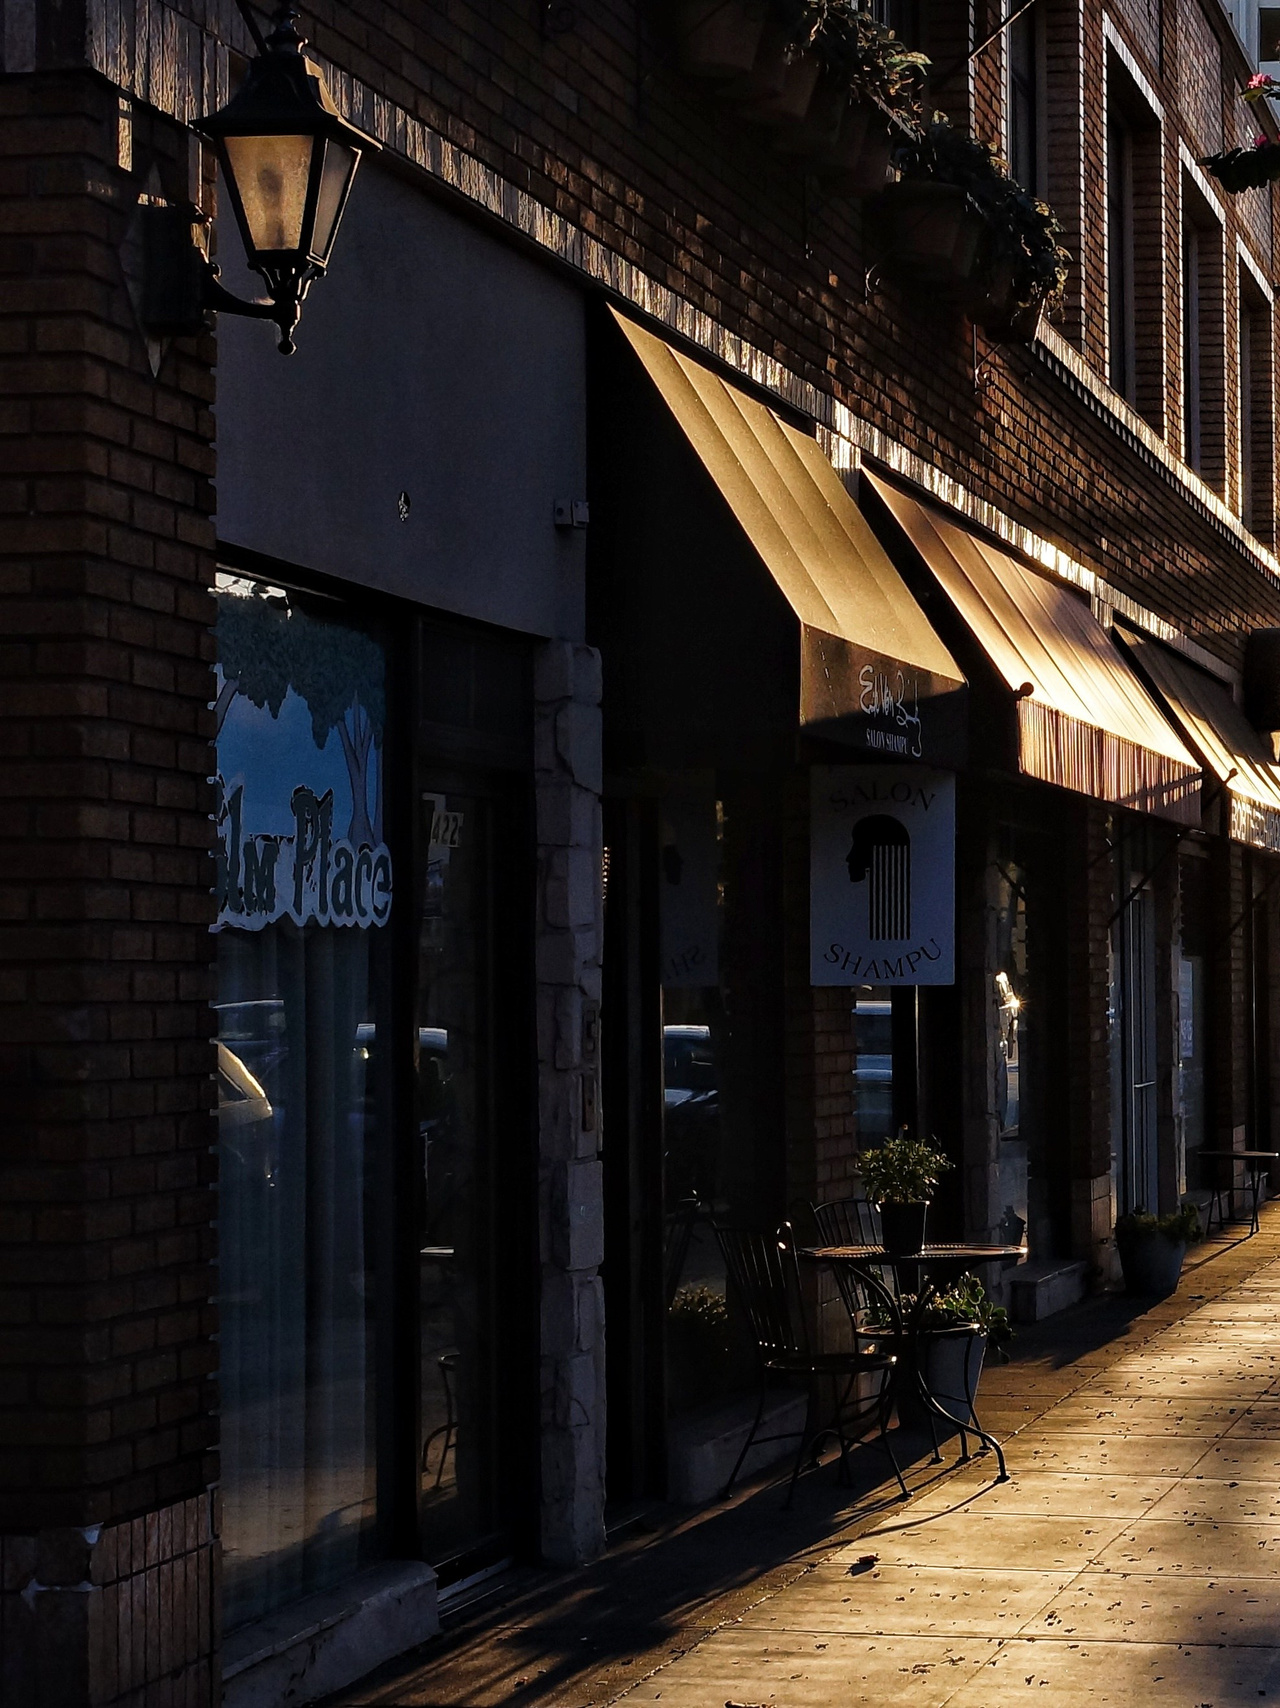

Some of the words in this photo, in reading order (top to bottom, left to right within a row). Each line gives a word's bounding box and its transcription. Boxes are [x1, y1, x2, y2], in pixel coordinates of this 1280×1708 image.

[830, 782, 935, 812] SALON
[292, 786, 392, 918] Place
[824, 938, 941, 979] SHAMPU
